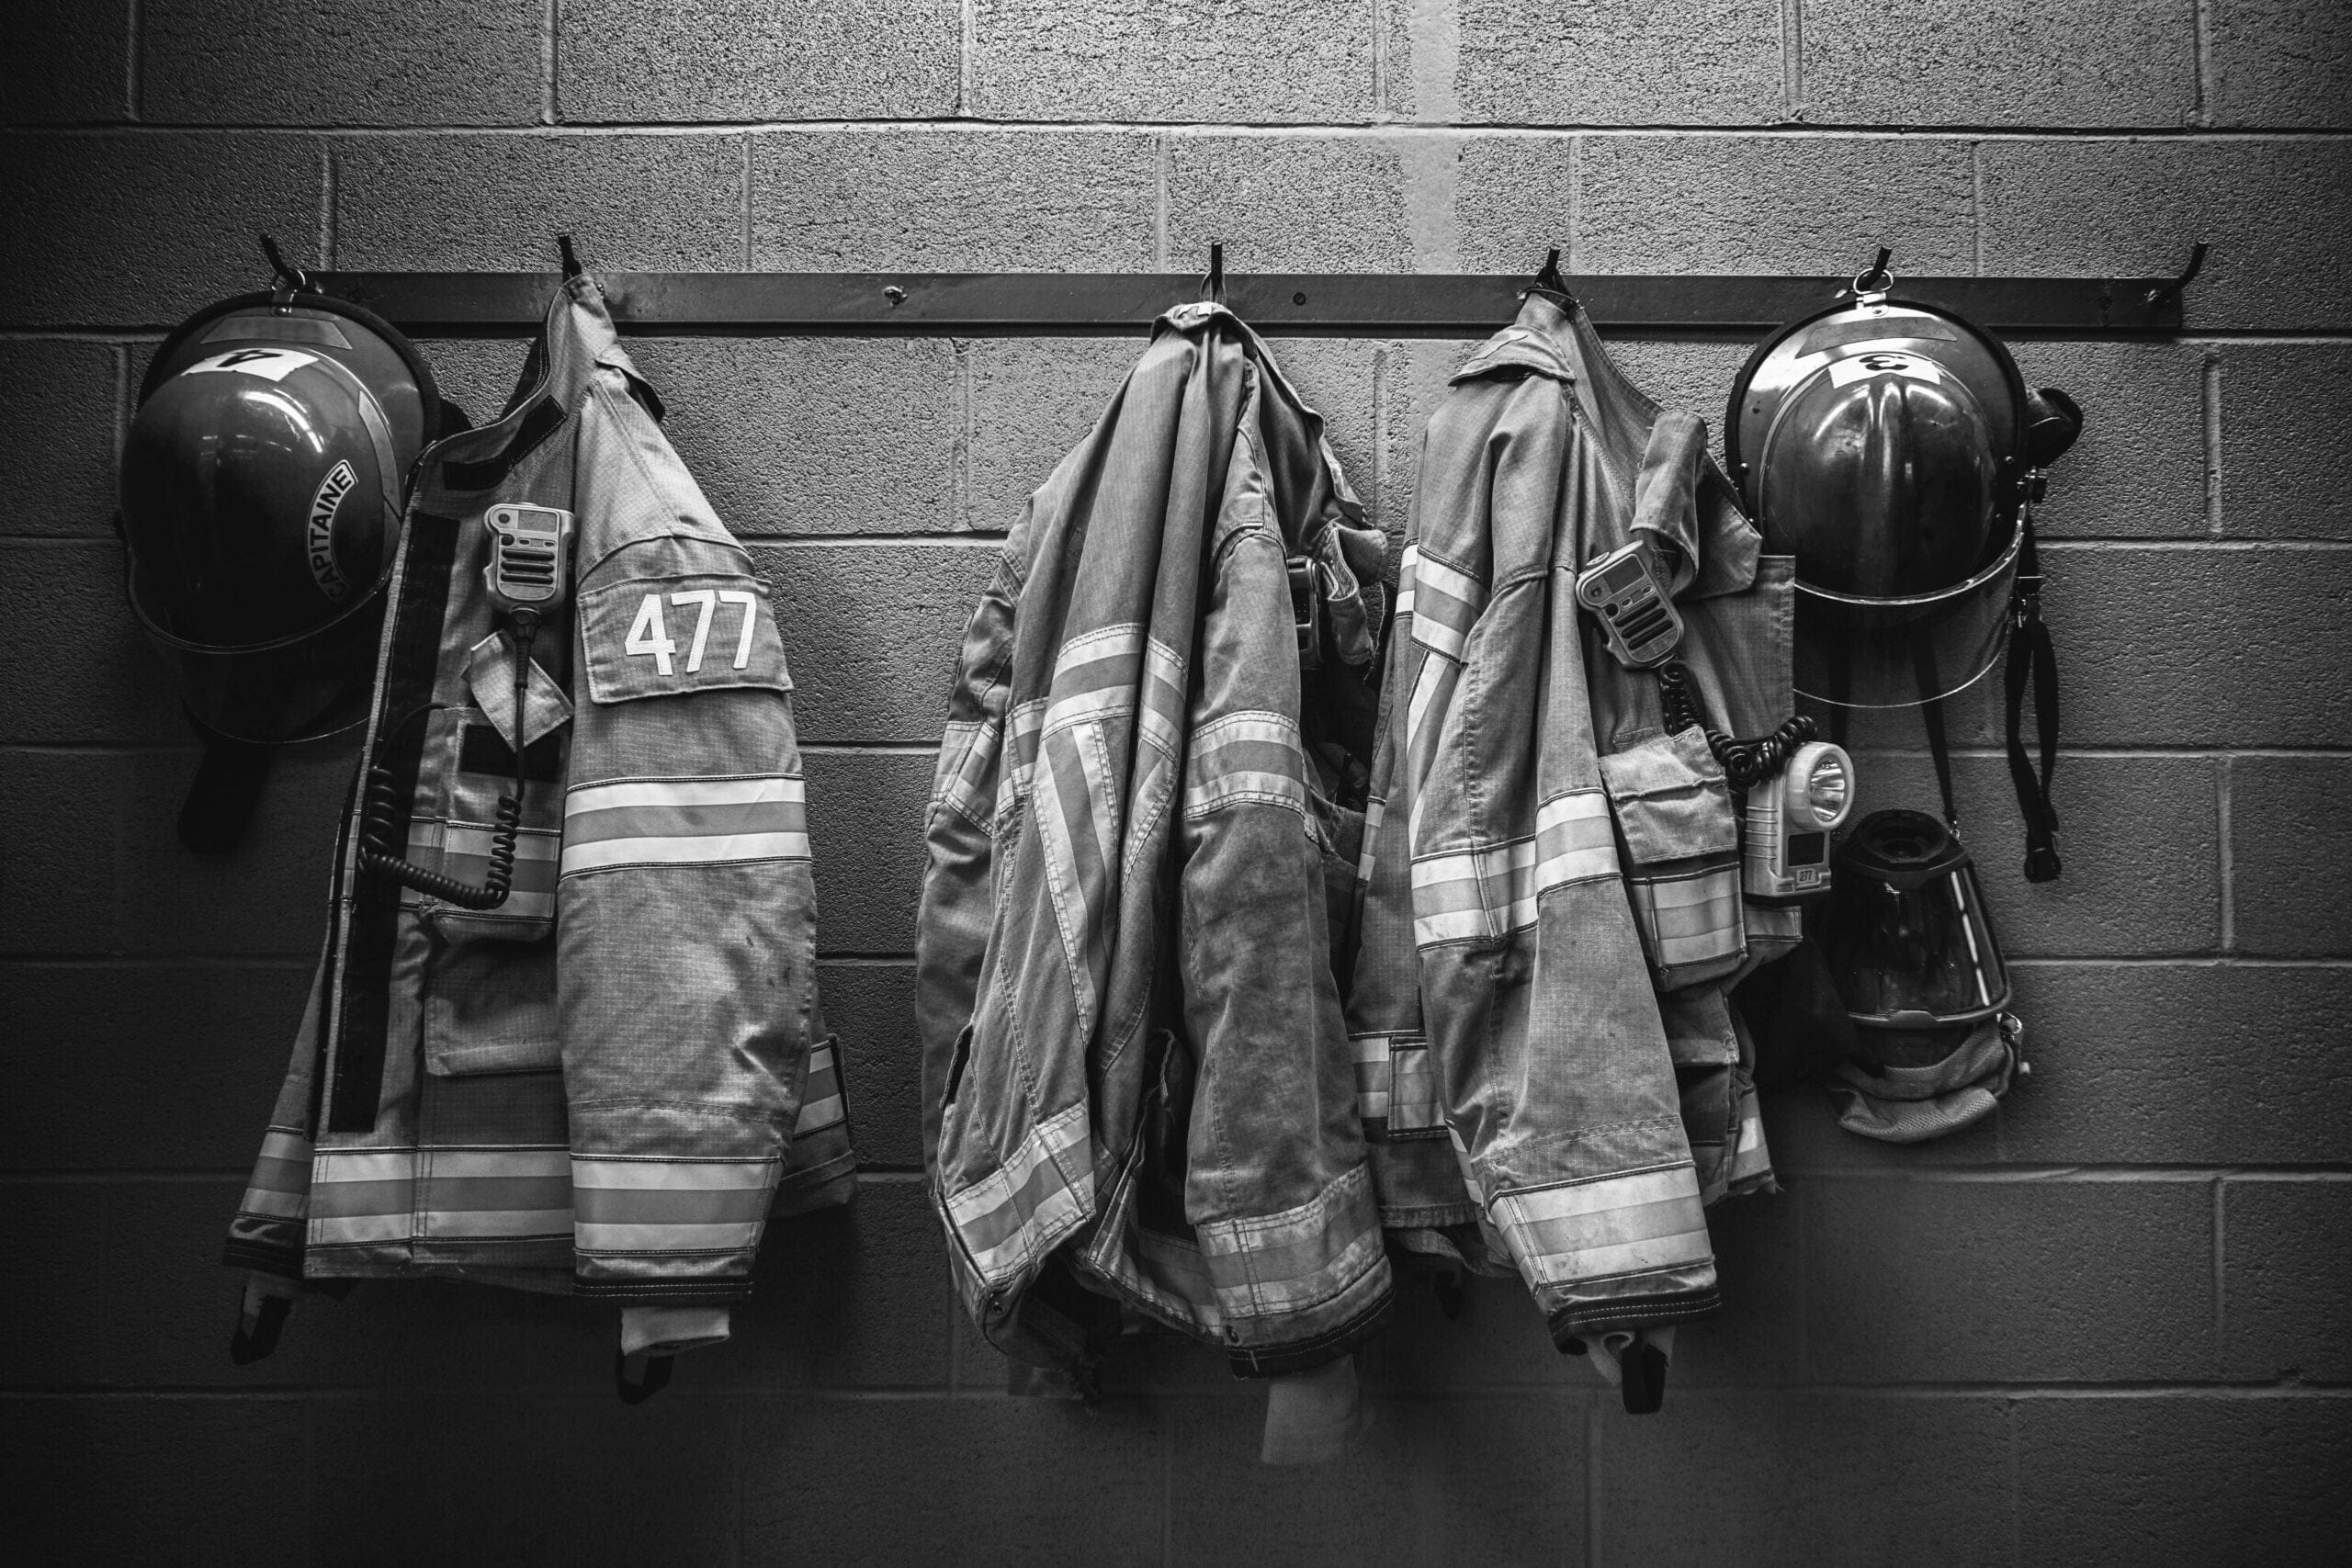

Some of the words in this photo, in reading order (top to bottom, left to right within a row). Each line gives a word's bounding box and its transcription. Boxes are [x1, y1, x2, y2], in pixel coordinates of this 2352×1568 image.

[216, 349, 284, 368] 4
[1859, 355, 1909, 371] 3
[311, 468, 352, 599] CAPITAINE
[625, 589, 757, 676] 477
[1800, 870, 1814, 882] 277
